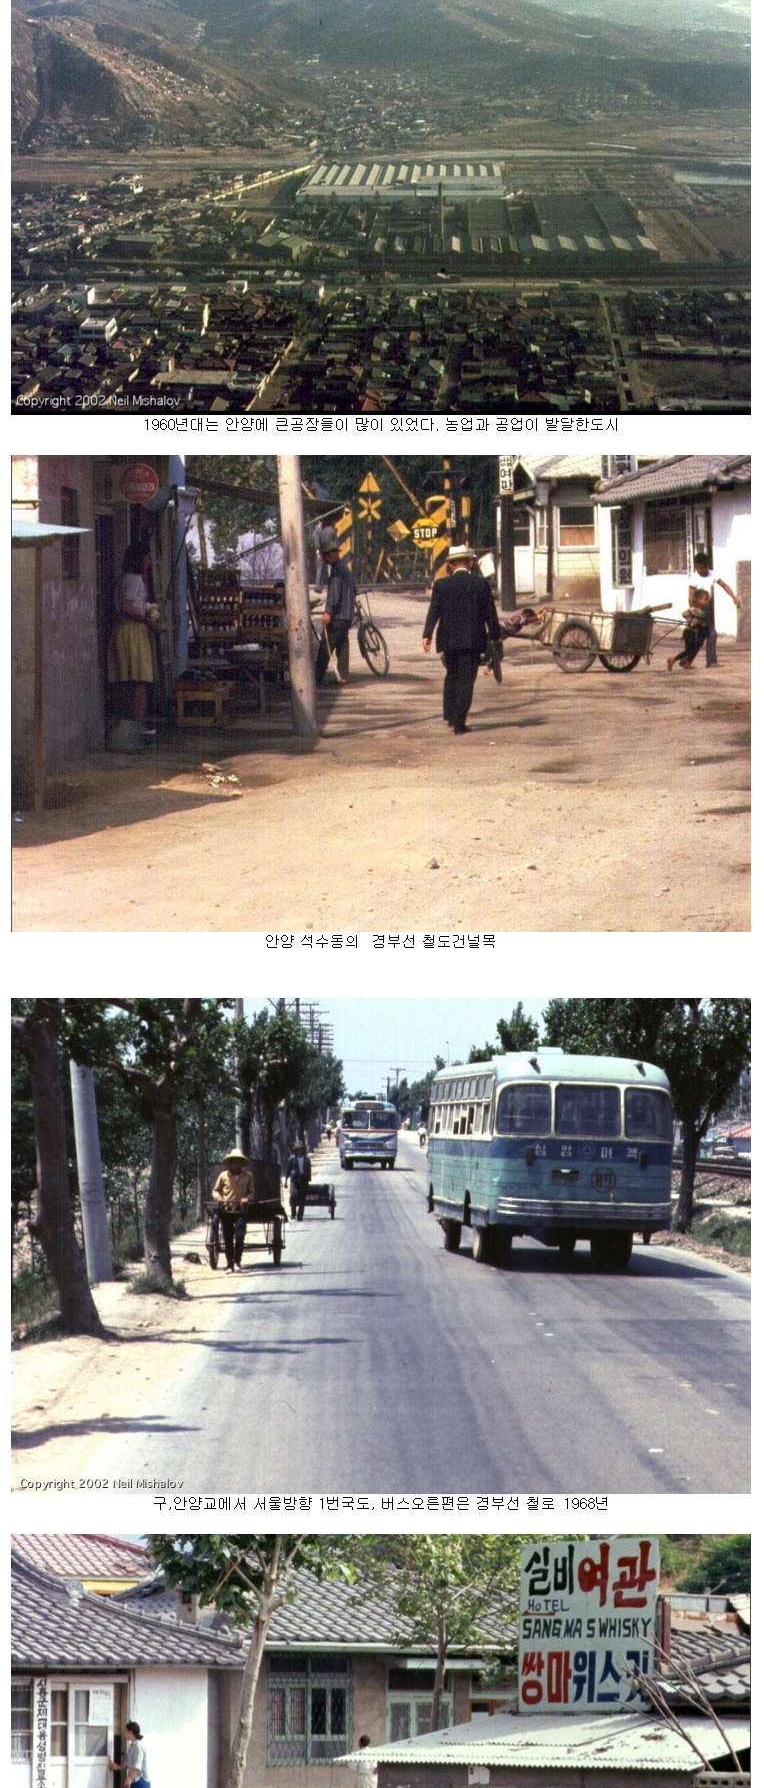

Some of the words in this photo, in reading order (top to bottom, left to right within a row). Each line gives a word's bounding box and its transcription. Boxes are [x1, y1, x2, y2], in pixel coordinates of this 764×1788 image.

[413, 527, 438, 539] STOP
[524, 1540, 657, 1609] 실비여관
[598, 1617, 653, 1640] WHISKY
